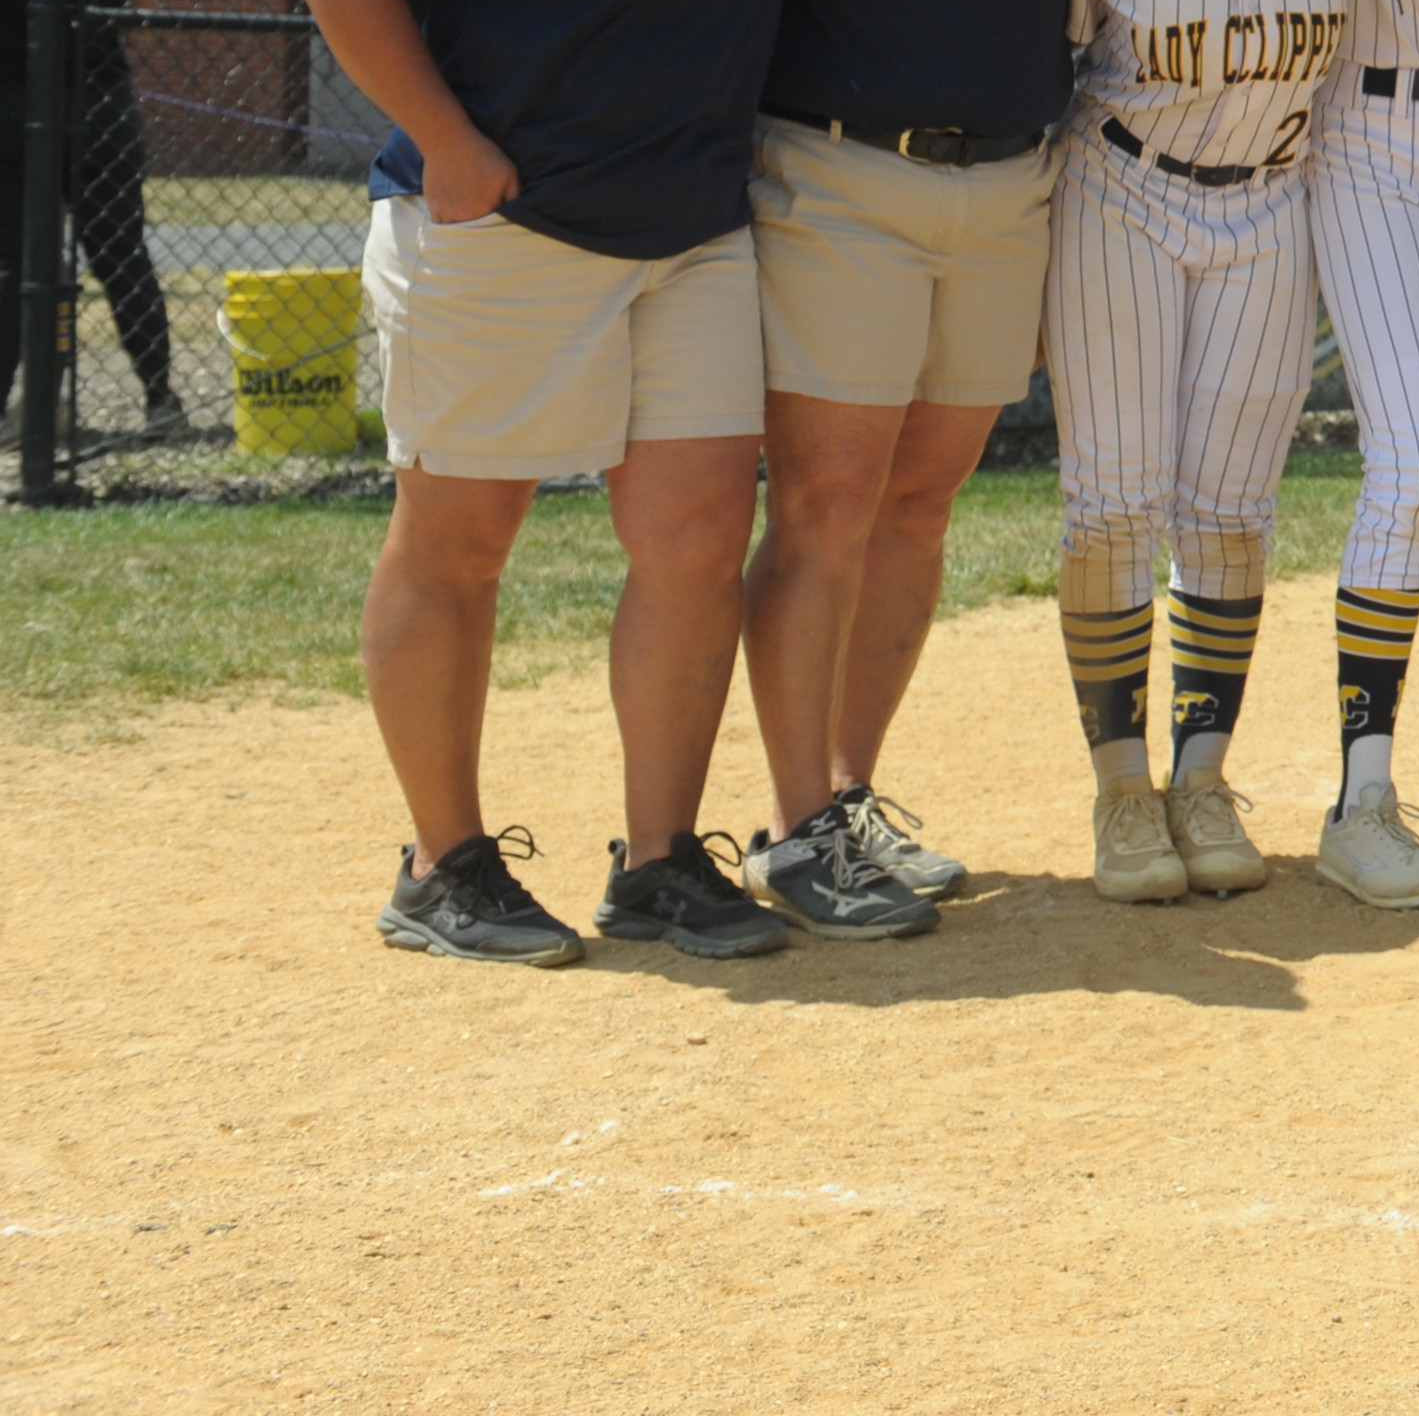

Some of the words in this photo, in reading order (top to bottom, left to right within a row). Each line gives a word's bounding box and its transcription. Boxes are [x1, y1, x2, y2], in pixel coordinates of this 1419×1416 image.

[1131, 19, 1207, 88] LADY
[1223, 11, 1347, 85] CLIPPE
[241, 368, 347, 395] Wilson
